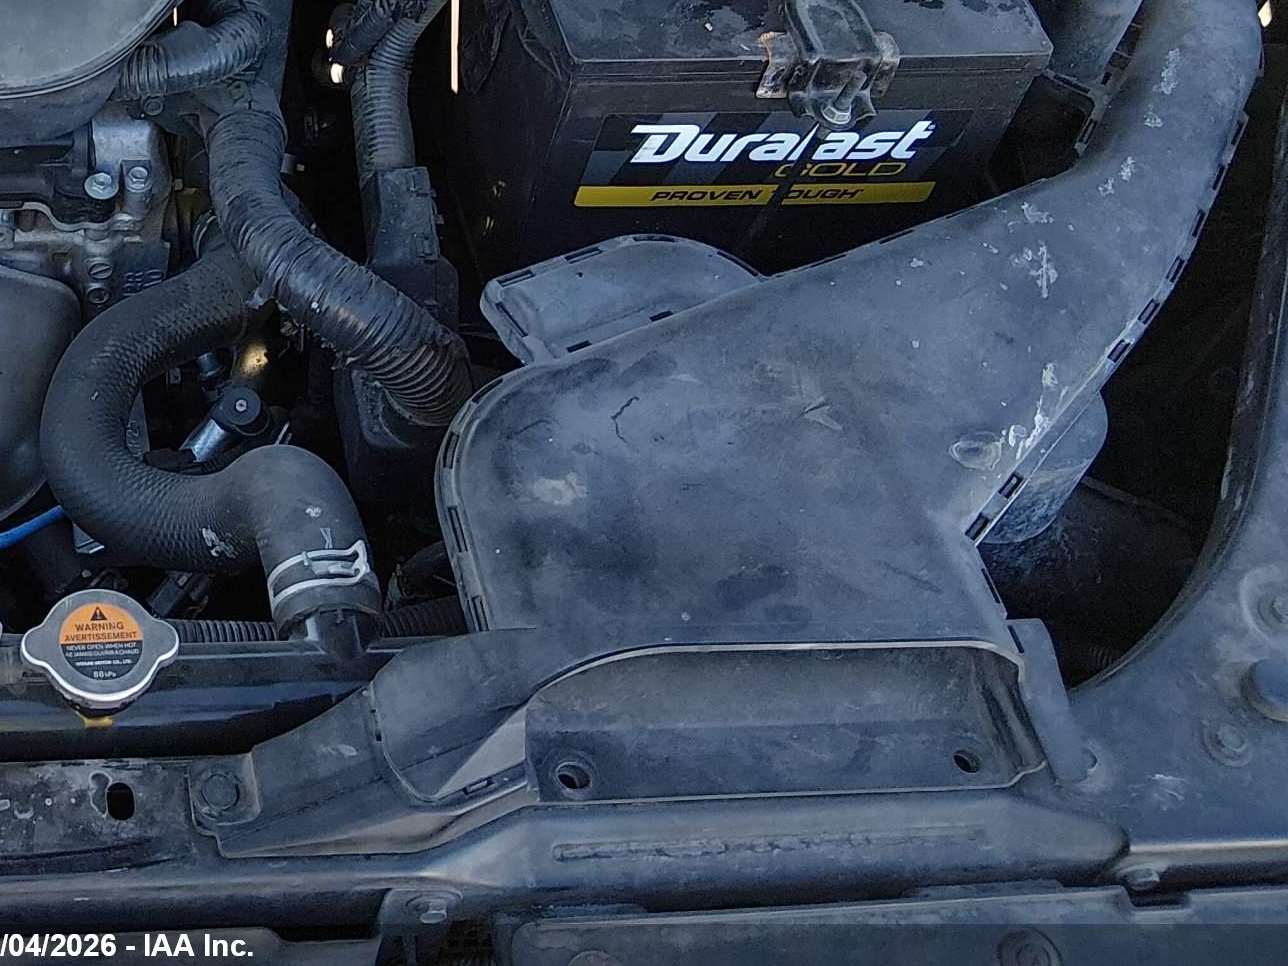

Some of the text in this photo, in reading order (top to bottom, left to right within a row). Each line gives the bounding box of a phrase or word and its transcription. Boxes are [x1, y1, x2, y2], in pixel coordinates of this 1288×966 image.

[650, 188, 856, 202] PROVEN OUGH
[74, 621, 124, 631] WARNING
[64, 631, 137, 642] AVERTISSEMENT
